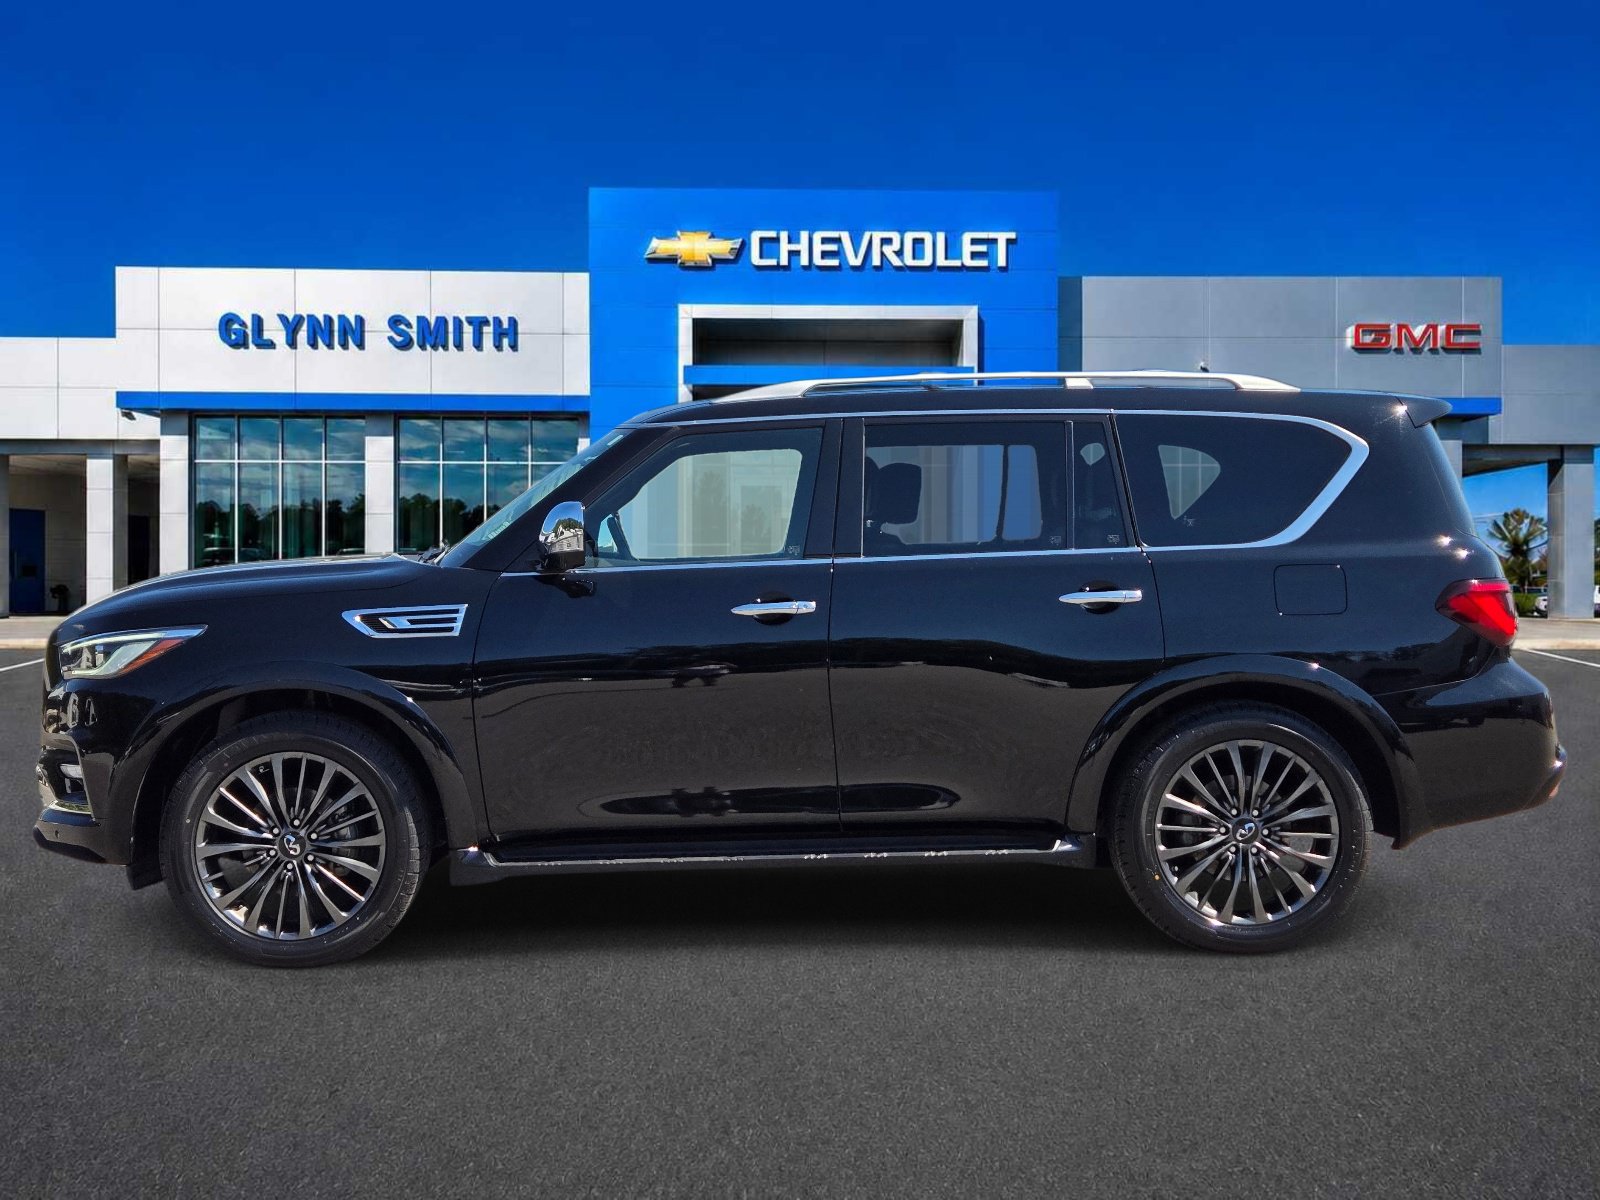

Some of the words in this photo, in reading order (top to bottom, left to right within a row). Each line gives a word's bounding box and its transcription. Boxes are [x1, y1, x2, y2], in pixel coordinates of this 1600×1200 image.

[750, 230, 1017, 268] CHEVROLET
[218, 312, 365, 350] GLYNN
[387, 314, 519, 352] SMITH
[1352, 323, 1481, 350] GMC
